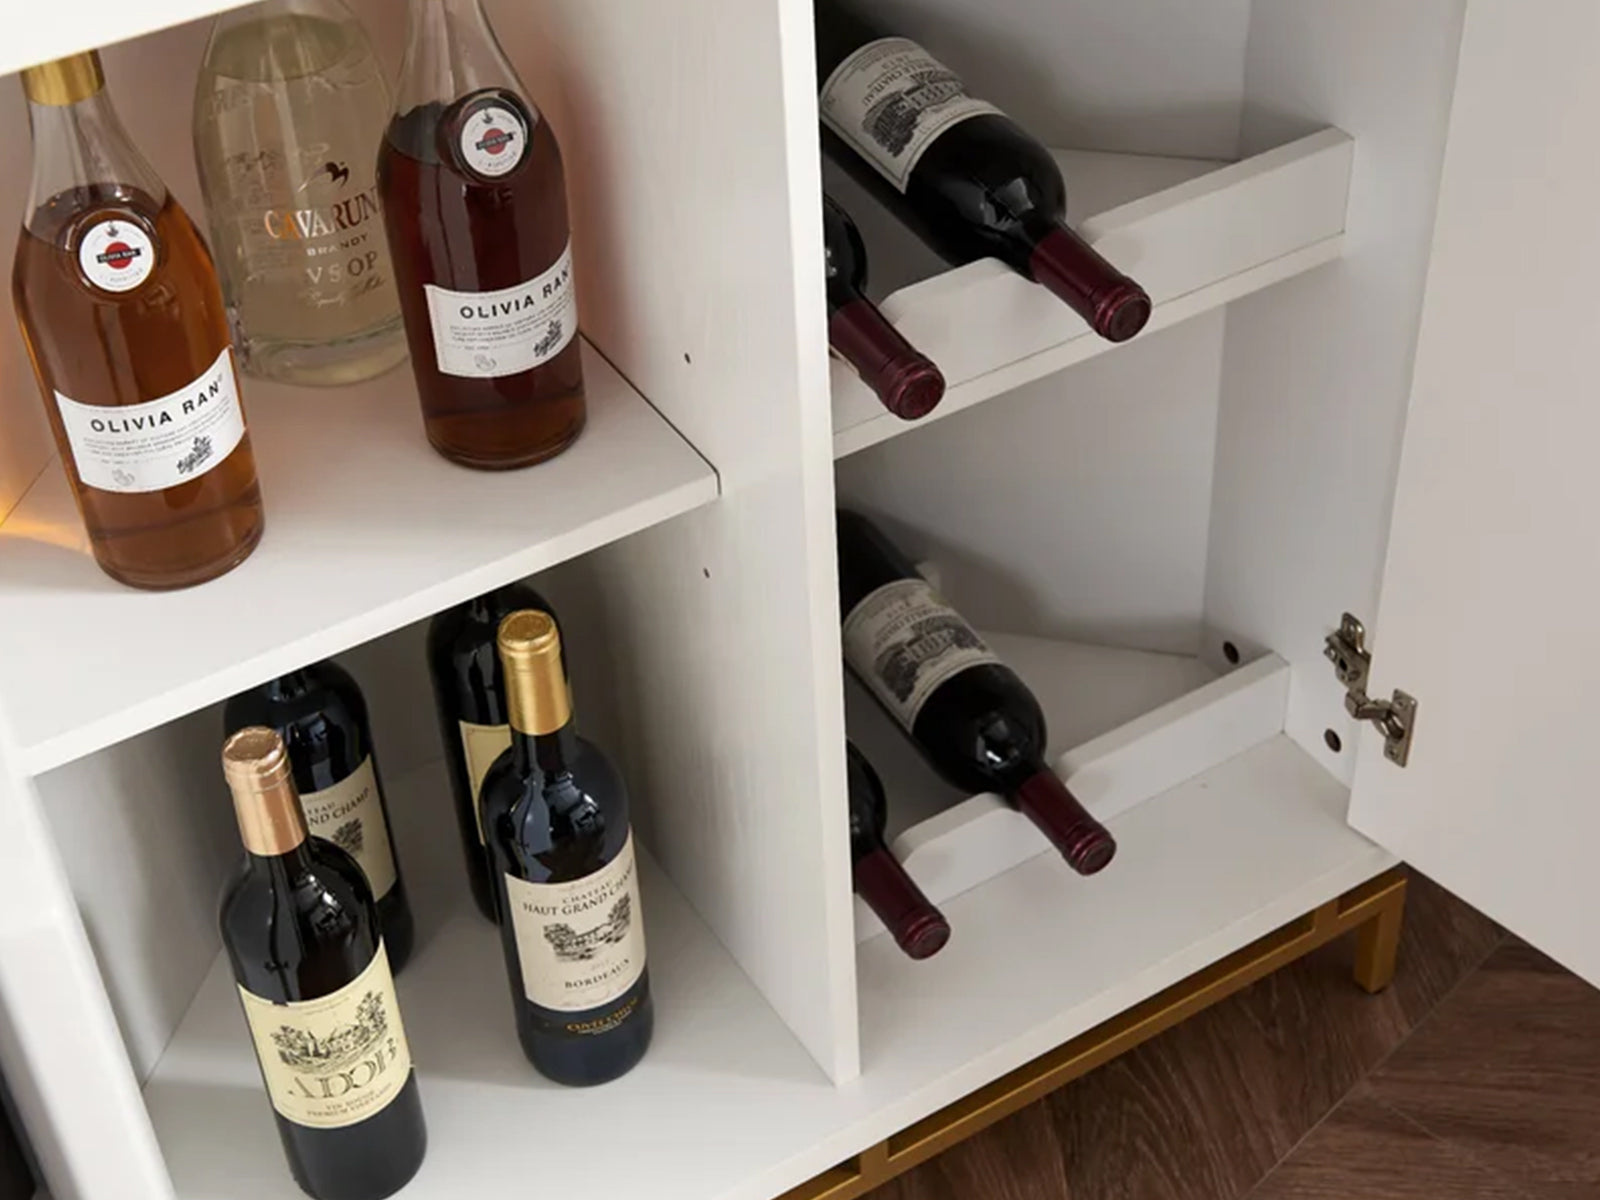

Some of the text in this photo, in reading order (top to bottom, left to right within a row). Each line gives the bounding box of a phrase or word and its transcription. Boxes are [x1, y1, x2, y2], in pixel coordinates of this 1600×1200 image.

[305, 233, 369, 257] BRANDY
[459, 295, 535, 319] OLIVIA
[542, 268, 570, 299] RAN
[91, 411, 174, 433] OLIVIA
[182, 380, 221, 416] RAN
[523, 902, 558, 916] HAUT
[561, 892, 608, 915] GRAND
[562, 879, 613, 904] CHATEAU
[565, 957, 630, 989] BORDEAUX
